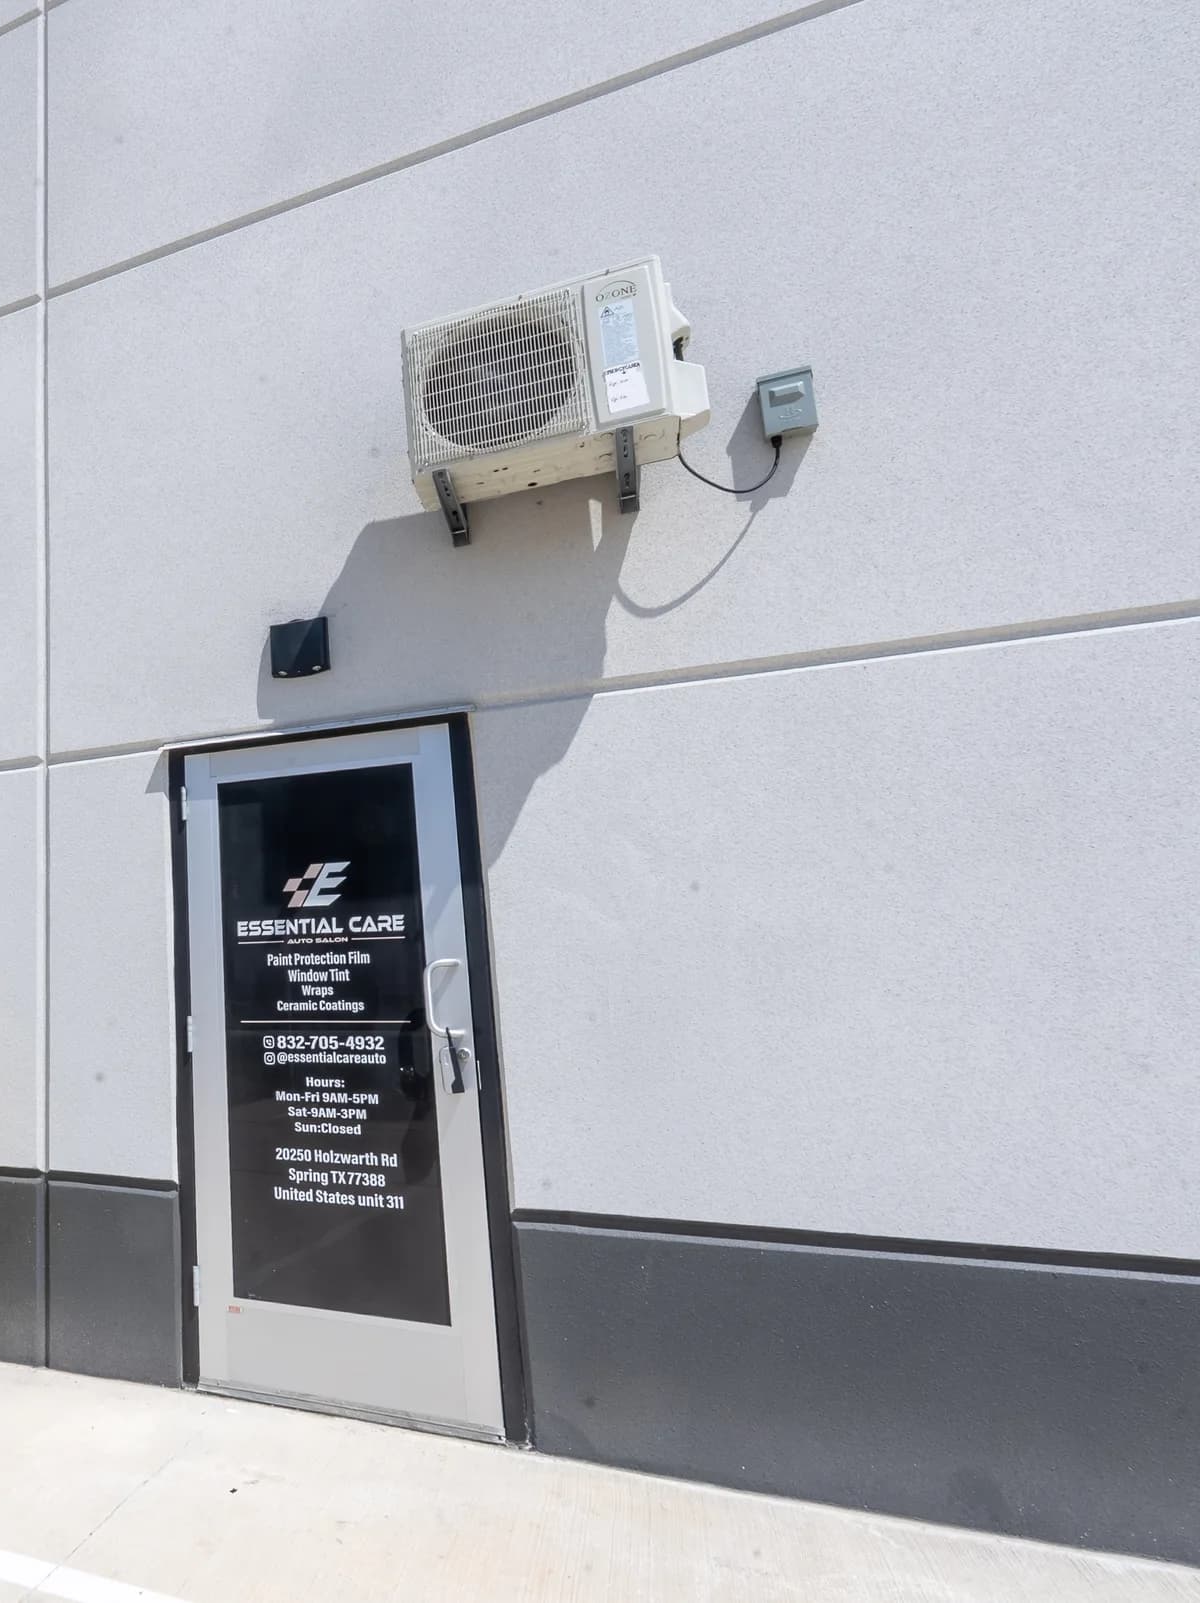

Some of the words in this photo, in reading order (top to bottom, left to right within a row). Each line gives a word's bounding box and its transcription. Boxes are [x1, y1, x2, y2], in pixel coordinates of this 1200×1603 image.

[237, 917, 344, 937] ESSENTIAL
[348, 914, 405, 933] CARE
[315, 936, 349, 944] SALON
[267, 953, 293, 966] Paint
[294, 952, 346, 966] Protection
[348, 951, 371, 965] Film
[288, 969, 328, 982] Window
[329, 968, 350, 982] Tint
[301, 985, 334, 998] Wraps
[277, 1000, 317, 1012] Ceramic
[319, 1000, 365, 1013] Coatings
[277, 1035, 385, 1050] 832-705-4932
[277, 1051, 387, 1065] @essentialcareauto
[305, 1076, 345, 1088] Hours:
[275, 1091, 320, 1102] Mon-Fri
[322, 1093, 379, 1105] 9AM-5PM
[288, 1106, 367, 1120] Sat-9AM-3PM
[294, 1122, 362, 1135] Sun:Closed
[275, 1148, 312, 1162] 20250
[314, 1150, 378, 1166] Holzwarth
[381, 1153, 398, 1167] Rd
[288, 1168, 329, 1185] Spring
[330, 1171, 346, 1184] TX
[347, 1172, 386, 1187] 77388
[274, 1186, 314, 1202] United
[315, 1190, 355, 1206] States
[358, 1194, 384, 1208] unit
[386, 1195, 404, 1209] 311
